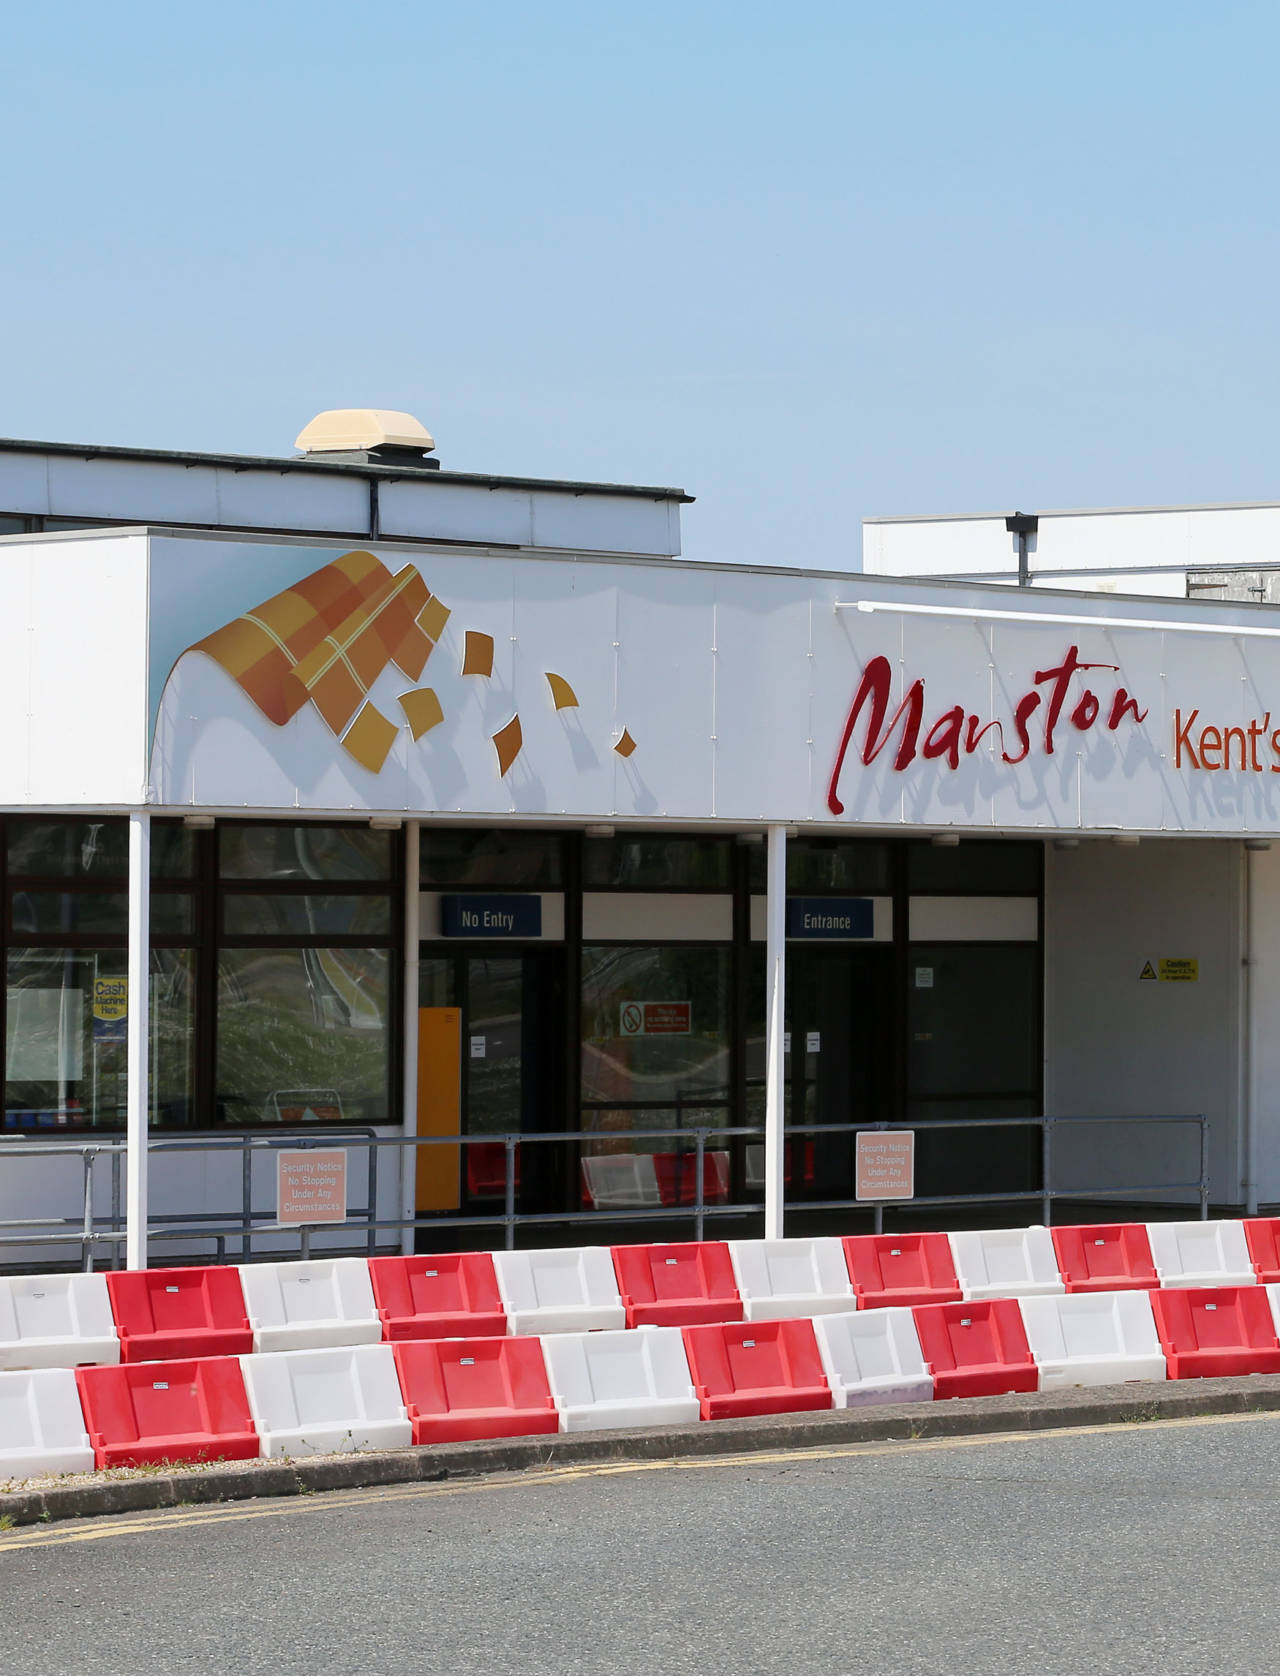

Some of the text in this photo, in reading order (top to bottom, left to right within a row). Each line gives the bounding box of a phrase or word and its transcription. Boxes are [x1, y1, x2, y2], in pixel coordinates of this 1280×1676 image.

[828, 646, 1146, 815] Manston
[462, 911, 514, 931] No Entry
[804, 913, 851, 929] Entrance
[96, 981, 125, 995] Cash
[282, 1162, 343, 1174] Security Notice
[289, 1176, 337, 1187] No Stopping
[292, 1189, 332, 1199] Under Any
[285, 1202, 340, 1212] Circumstances
